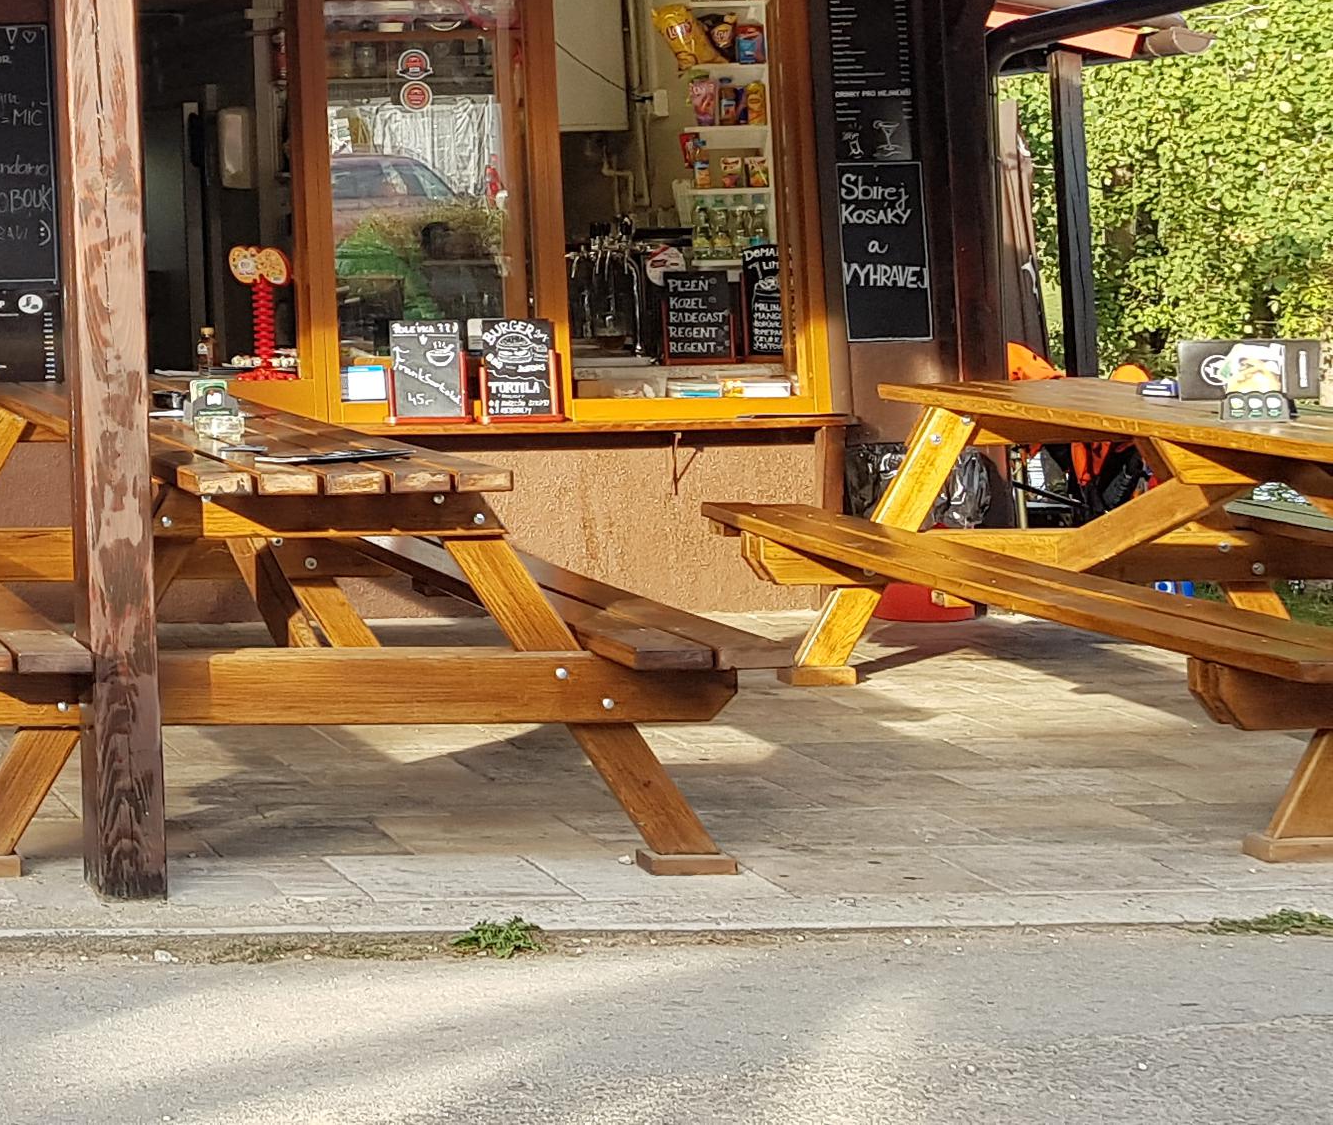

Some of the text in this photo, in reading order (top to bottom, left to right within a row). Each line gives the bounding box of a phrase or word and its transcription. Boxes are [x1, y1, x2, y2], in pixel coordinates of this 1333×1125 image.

[841, 173, 910, 211] Sbírej
[867, 240, 889, 254] a
[668, 311, 725, 323] RADEGAST
[482, 320, 535, 346] BURGER
[668, 325, 719, 338] REGENT
[668, 341, 717, 353] REGENT
